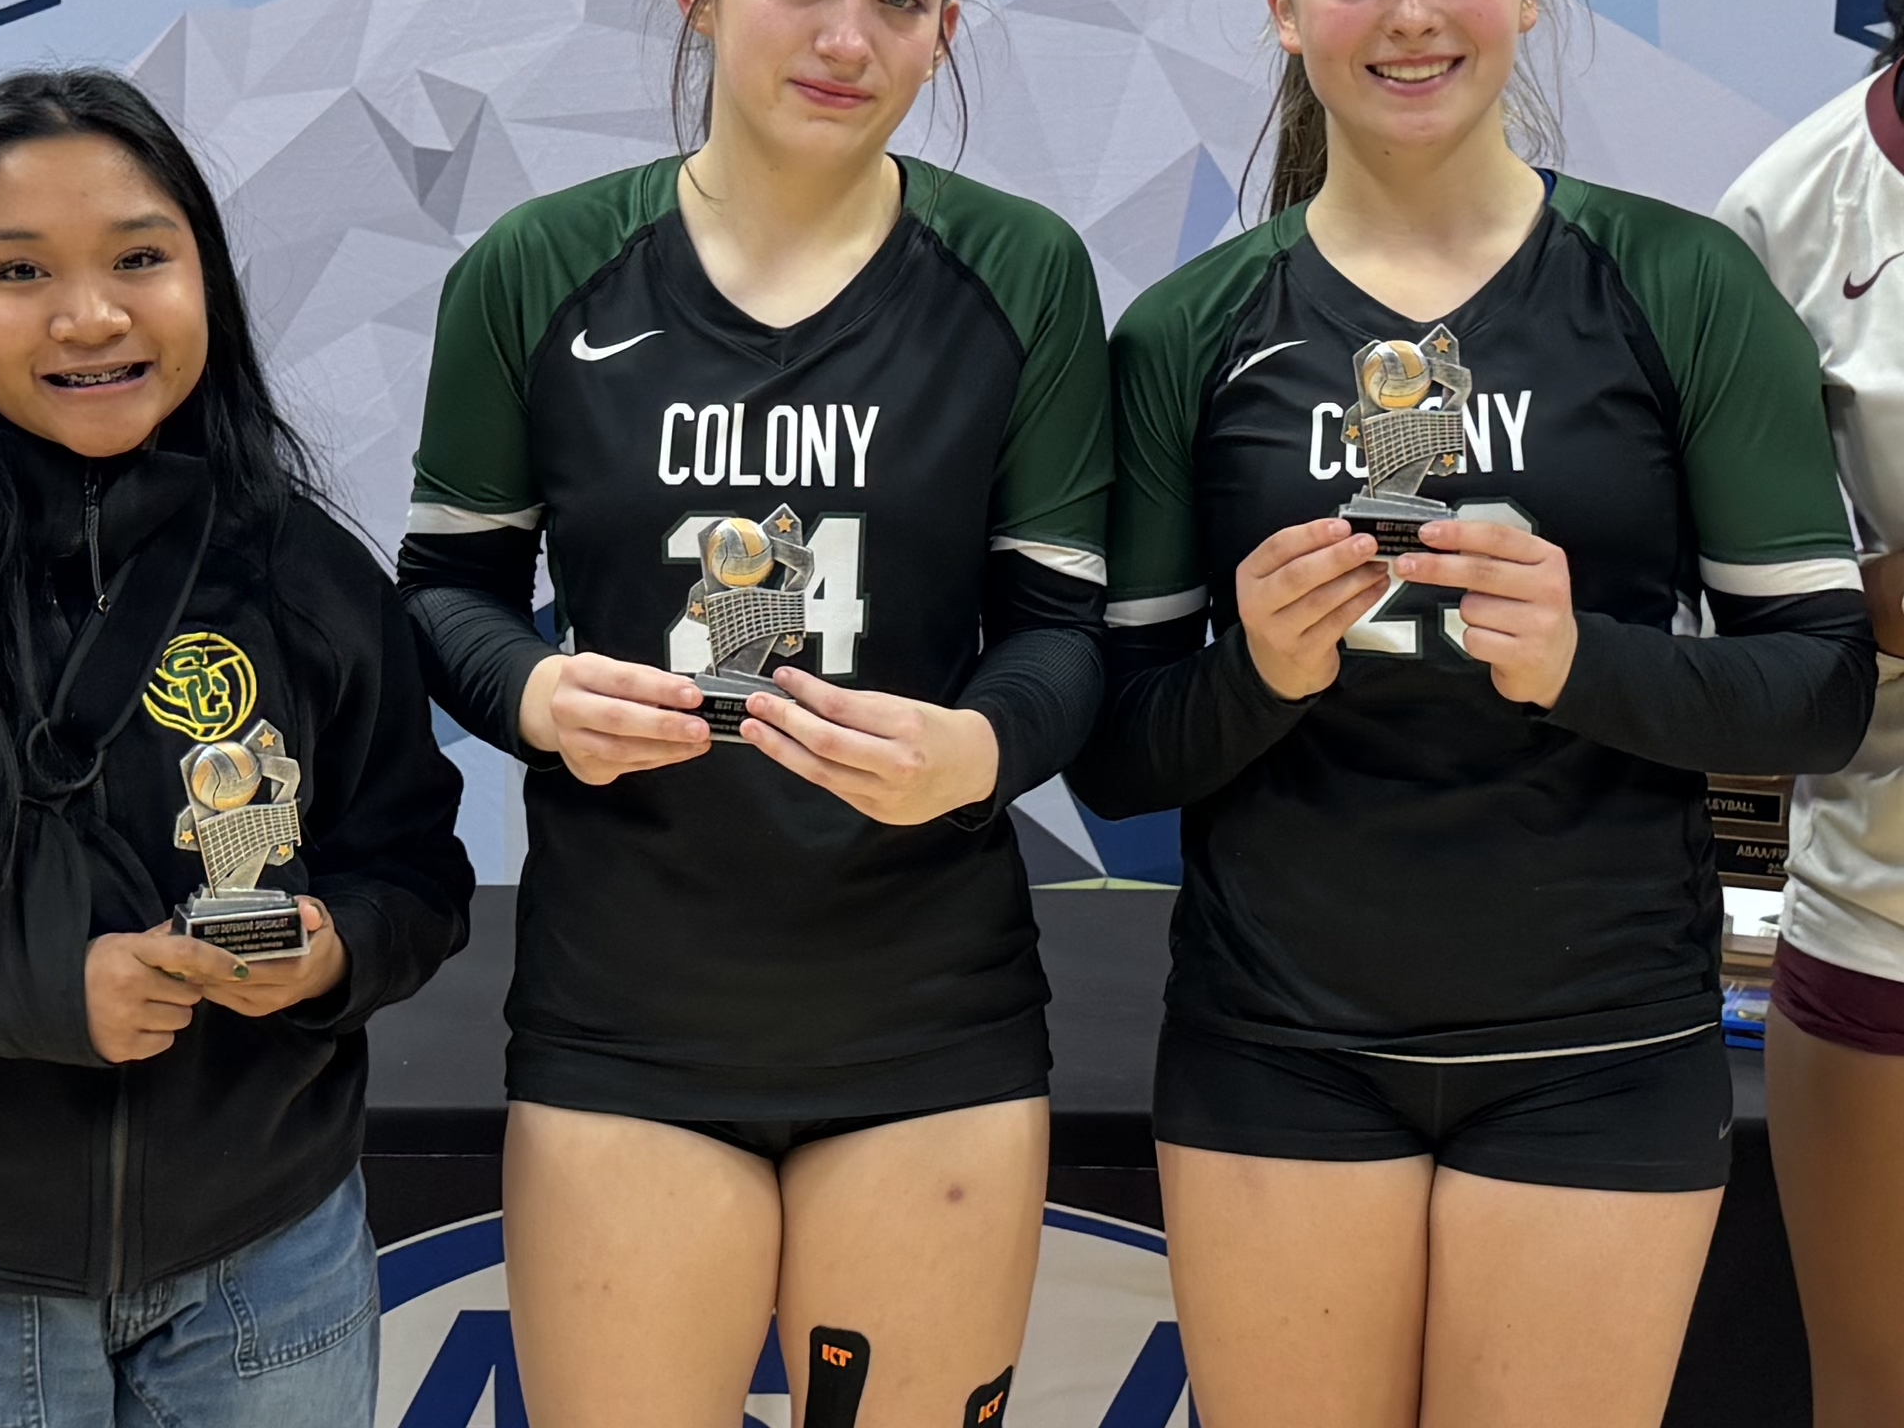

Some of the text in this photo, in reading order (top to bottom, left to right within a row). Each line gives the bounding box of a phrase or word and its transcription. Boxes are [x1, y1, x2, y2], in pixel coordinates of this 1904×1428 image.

[657, 401, 881, 488] COLONY
[1308, 389, 1533, 481] CNY
[221, 920, 254, 934] DEFENSIVE
[255, 917, 289, 930] SPECIALIST
[821, 1343, 853, 1368] KT
